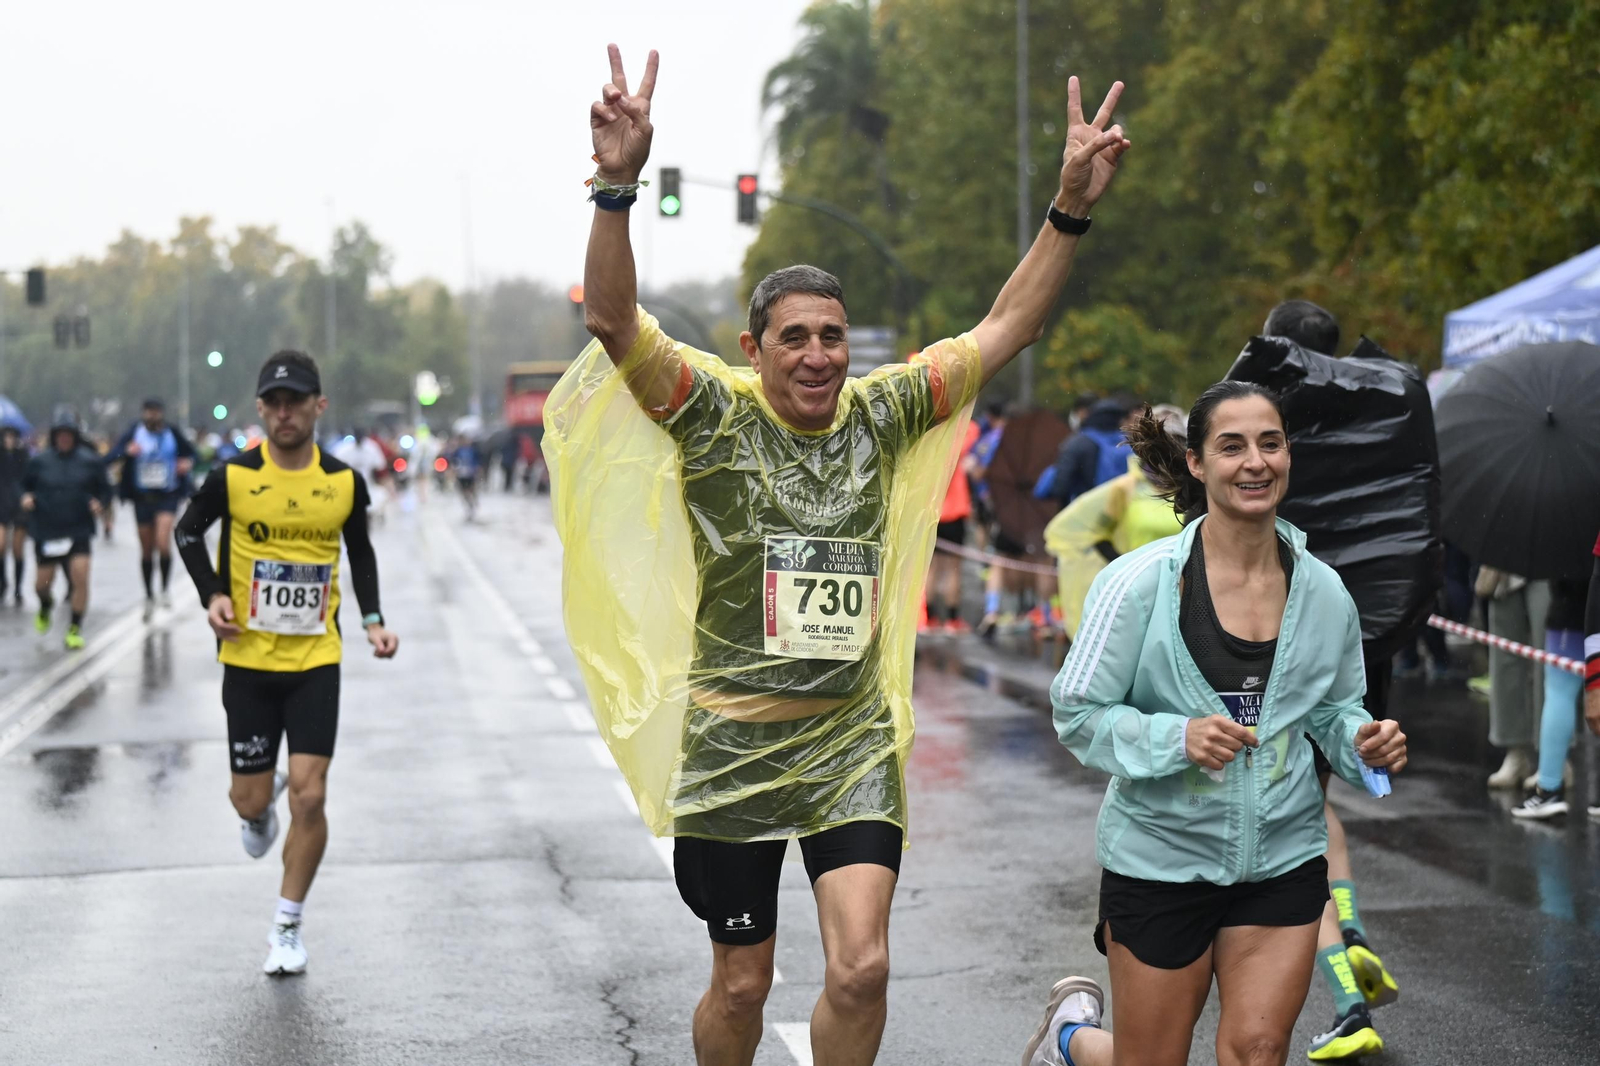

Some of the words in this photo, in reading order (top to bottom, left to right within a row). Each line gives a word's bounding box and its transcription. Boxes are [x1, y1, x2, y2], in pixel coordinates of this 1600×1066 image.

[828, 542, 865, 555] MEDIA
[781, 551, 807, 569] 39
[262, 584, 321, 609] 1083
[794, 578, 863, 617] 730
[801, 624, 820, 633] JOSE
[823, 625, 855, 635] MANUEL
[1327, 951, 1359, 995] HERE
